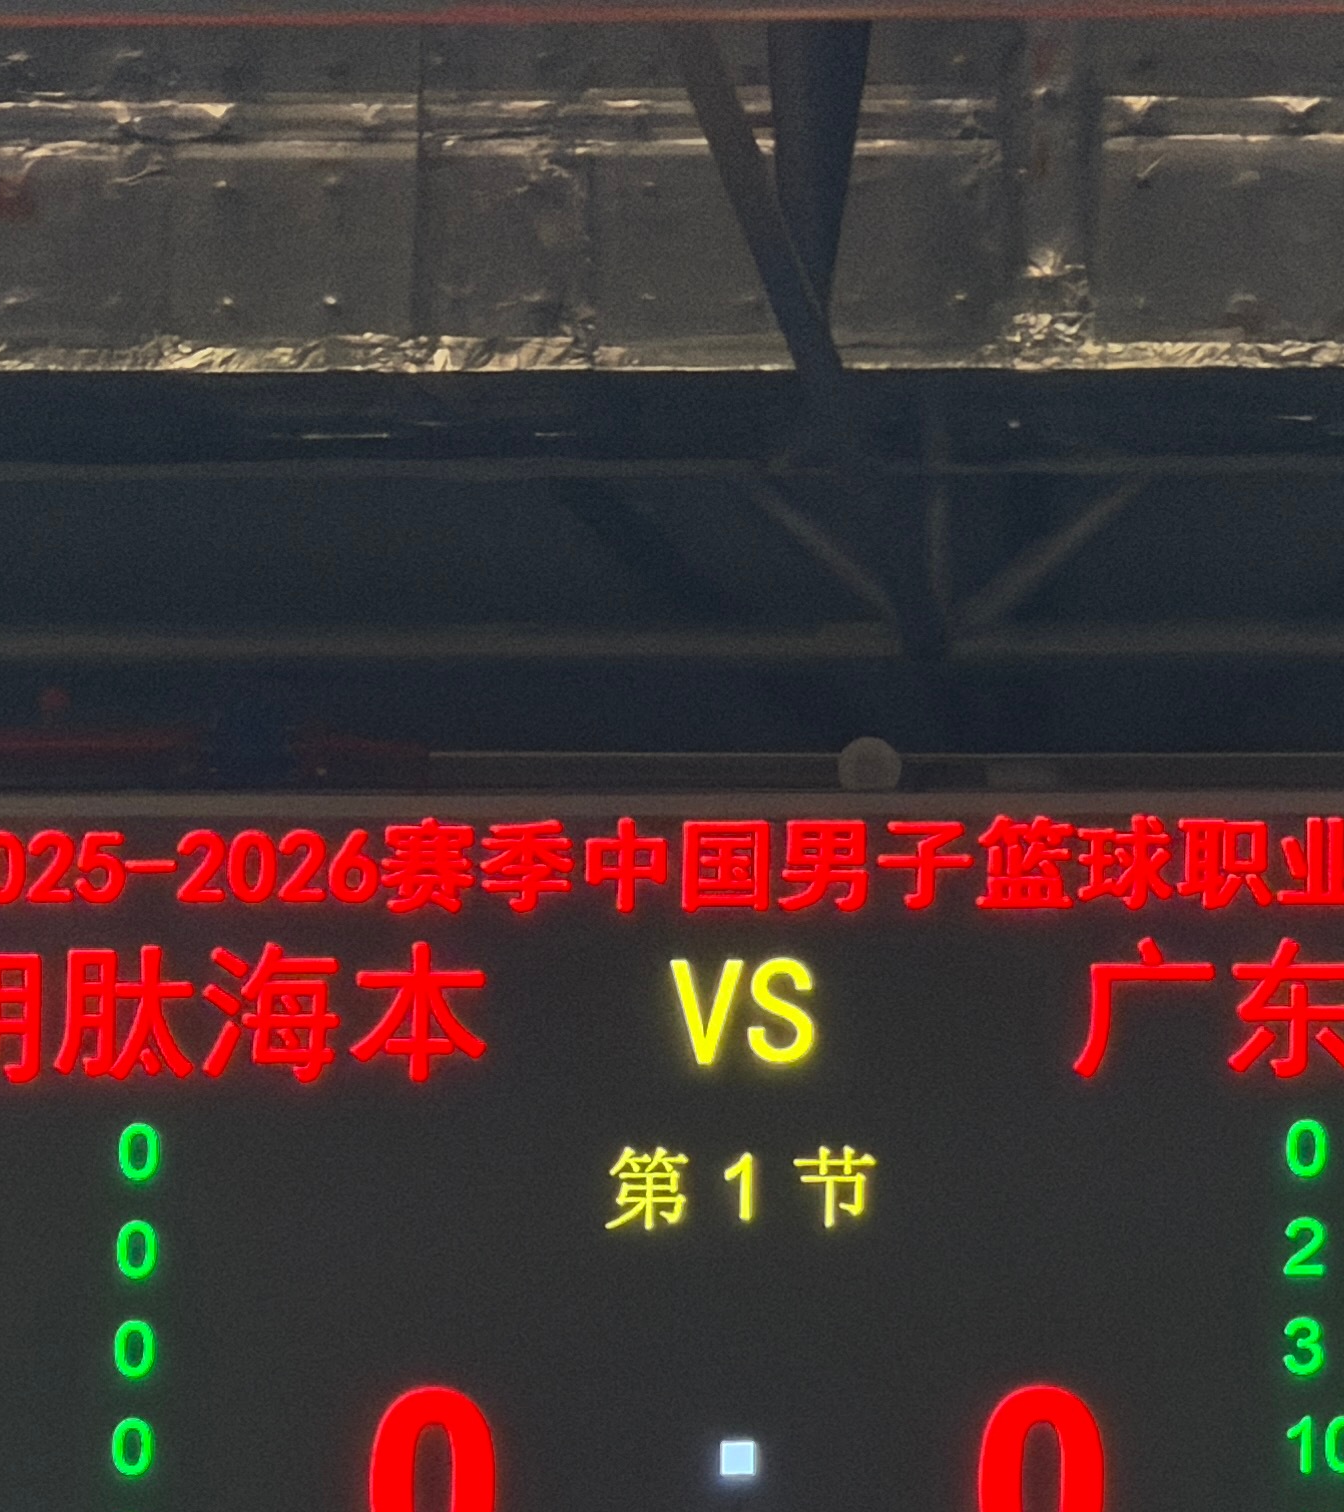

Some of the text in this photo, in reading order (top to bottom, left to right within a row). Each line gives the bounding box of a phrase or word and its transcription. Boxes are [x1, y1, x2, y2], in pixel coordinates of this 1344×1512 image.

[671, 957, 815, 1066] VS
[119, 1123, 159, 1181] 0
[1286, 1119, 1327, 1177] 0
[605, 1146, 876, 1230] 第 1 节
[117, 1220, 157, 1279] 0
[1283, 1217, 1325, 1276] 2
[114, 1320, 155, 1379] 0
[1283, 1317, 1324, 1375] 3
[112, 1418, 153, 1477] 0
